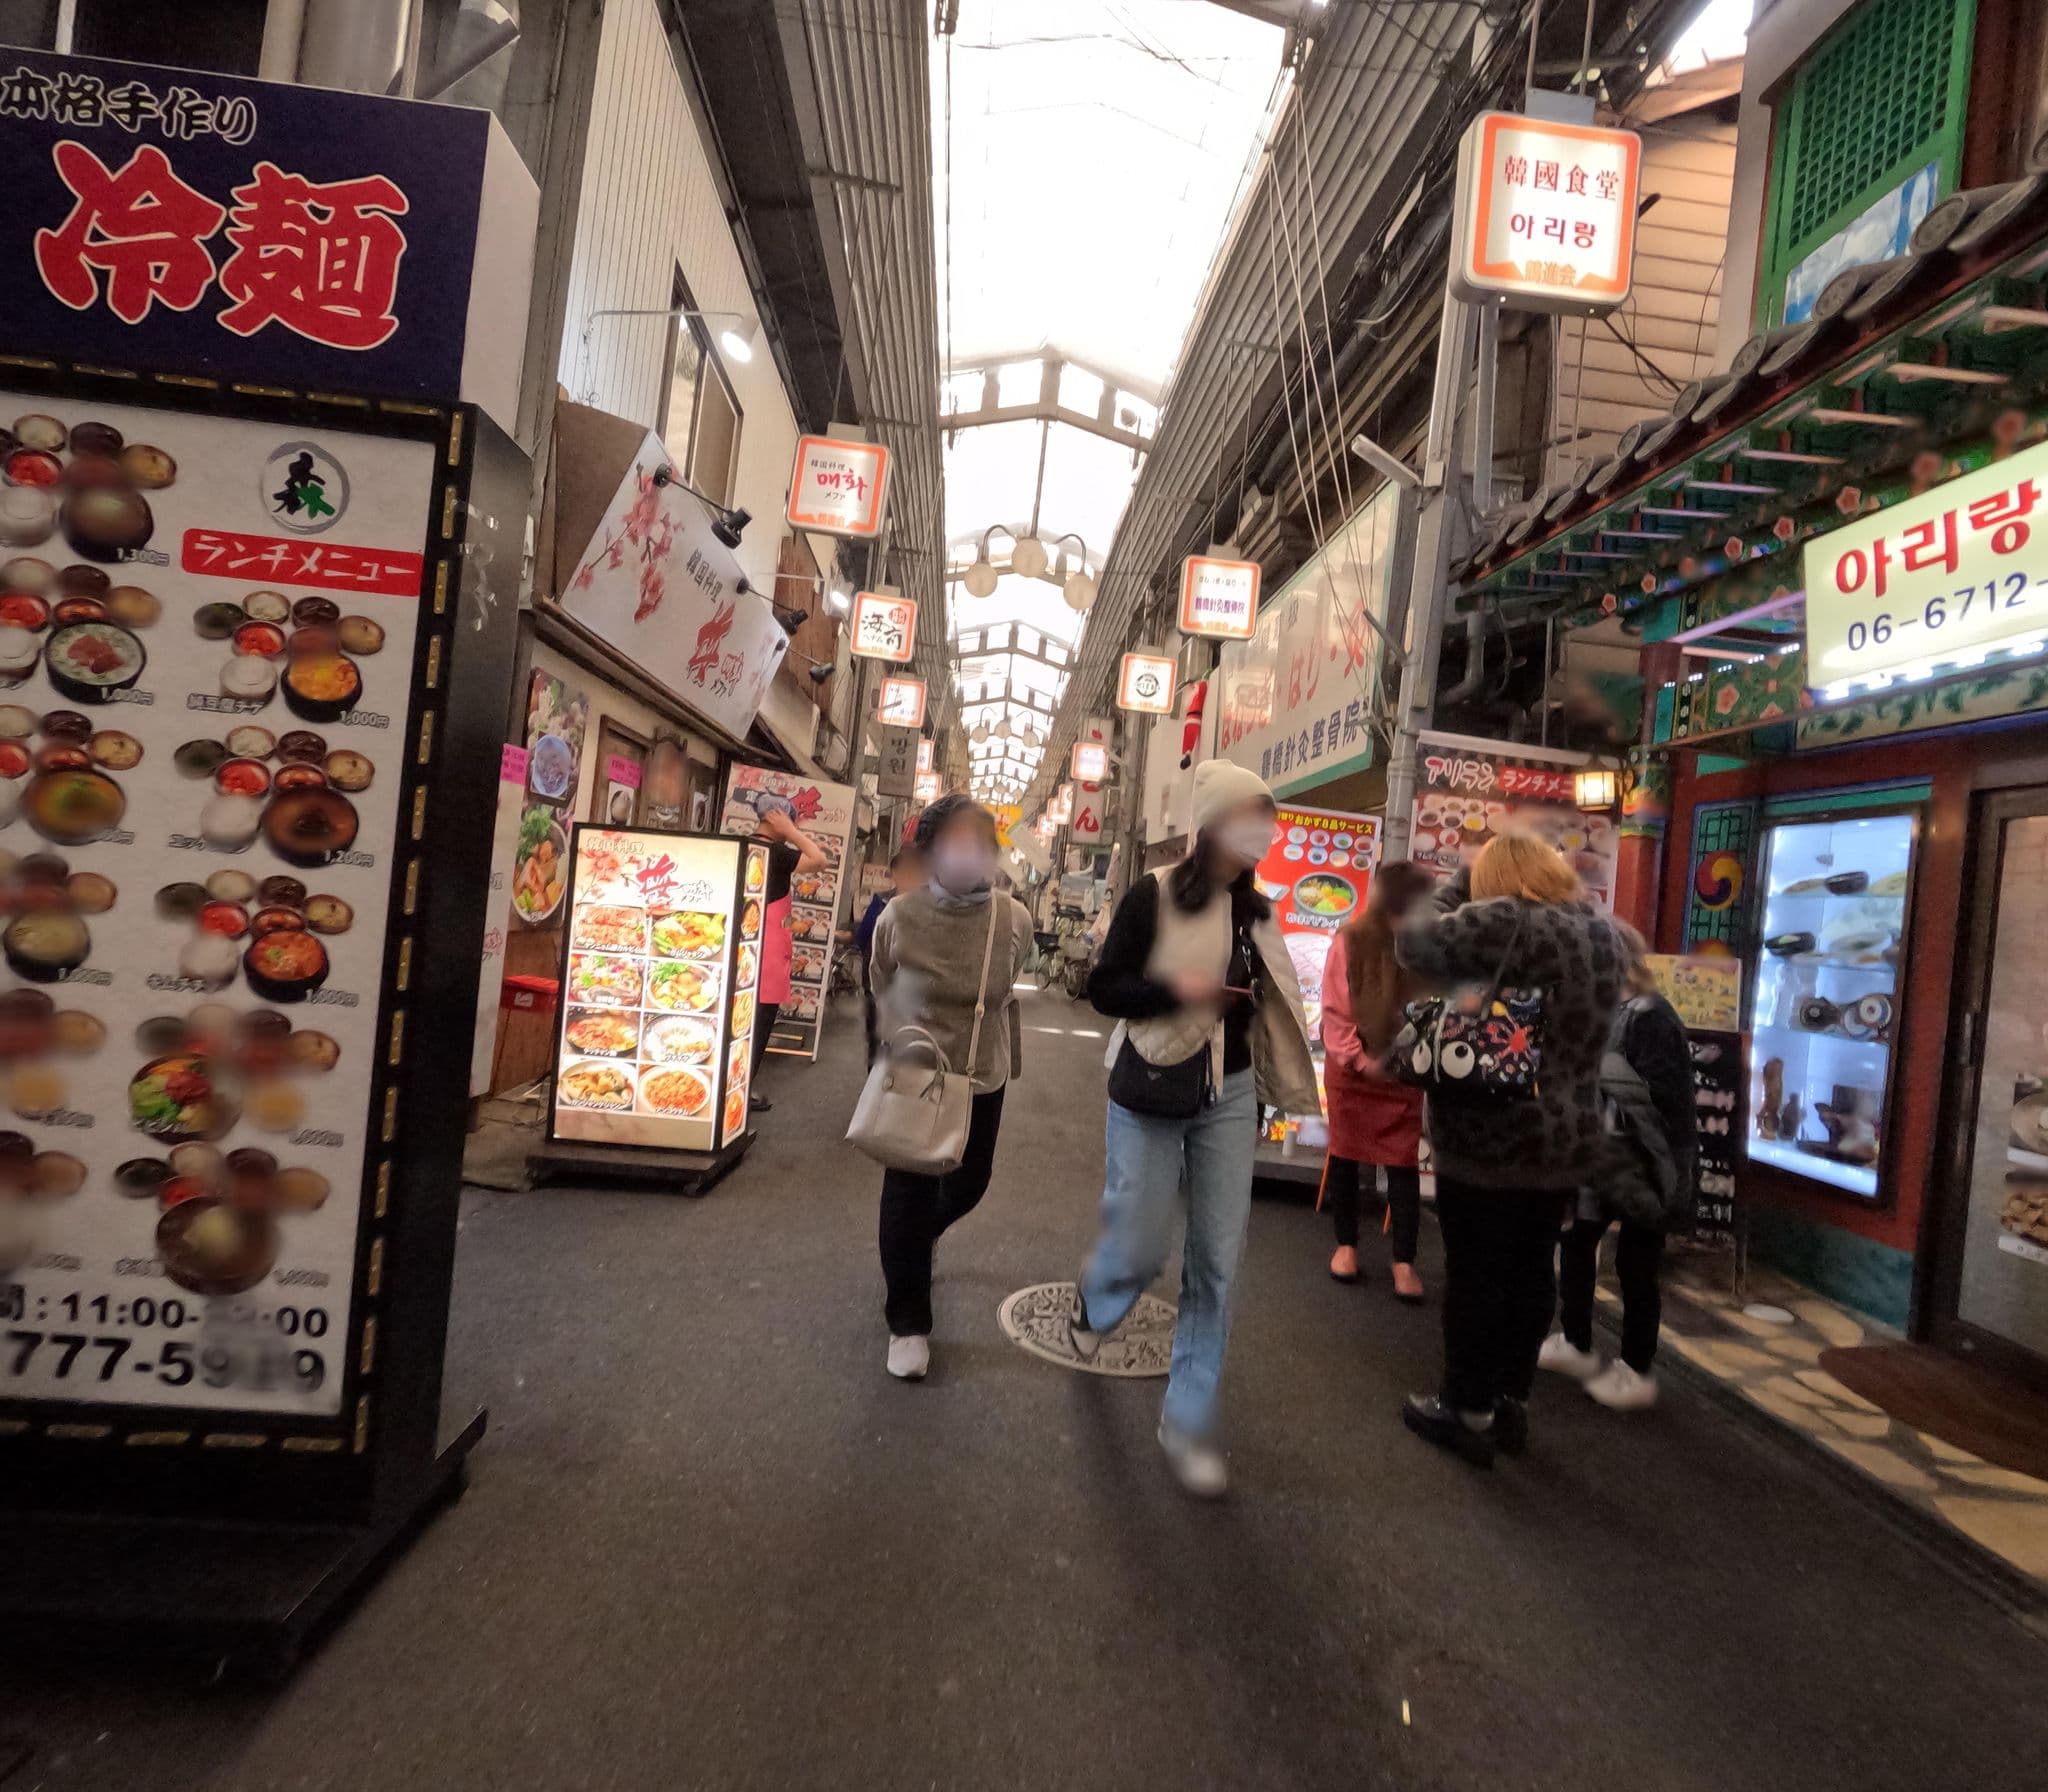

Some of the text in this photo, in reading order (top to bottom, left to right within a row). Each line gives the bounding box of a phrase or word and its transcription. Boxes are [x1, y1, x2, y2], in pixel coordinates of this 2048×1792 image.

[0, 67, 257, 145] 本格手作り
[1510, 213, 1597, 249] 아리랑
[194, 534, 418, 583] ランチメニュー
[1835, 478, 2041, 598] 아리랑
